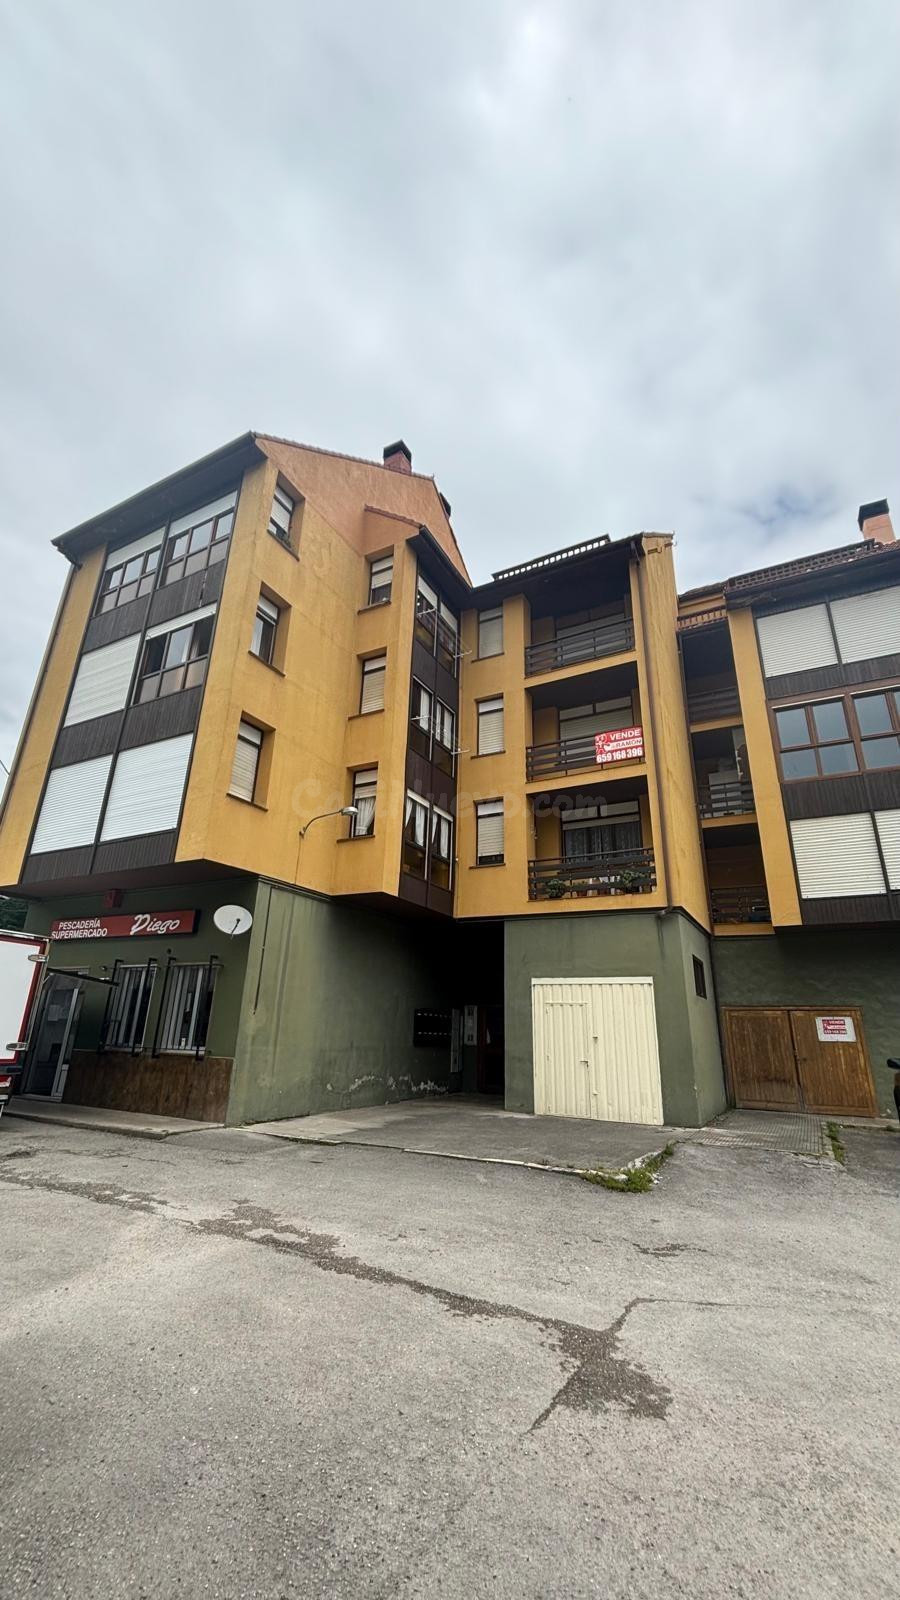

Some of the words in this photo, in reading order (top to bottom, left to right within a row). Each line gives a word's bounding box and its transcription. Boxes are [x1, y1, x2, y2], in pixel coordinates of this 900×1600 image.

[610, 729, 640, 740] VENDE
[59, 918, 101, 930] PESCADERÍA
[129, 913, 181, 936] Diego
[51, 928, 108, 939] SUPERMERCADO
